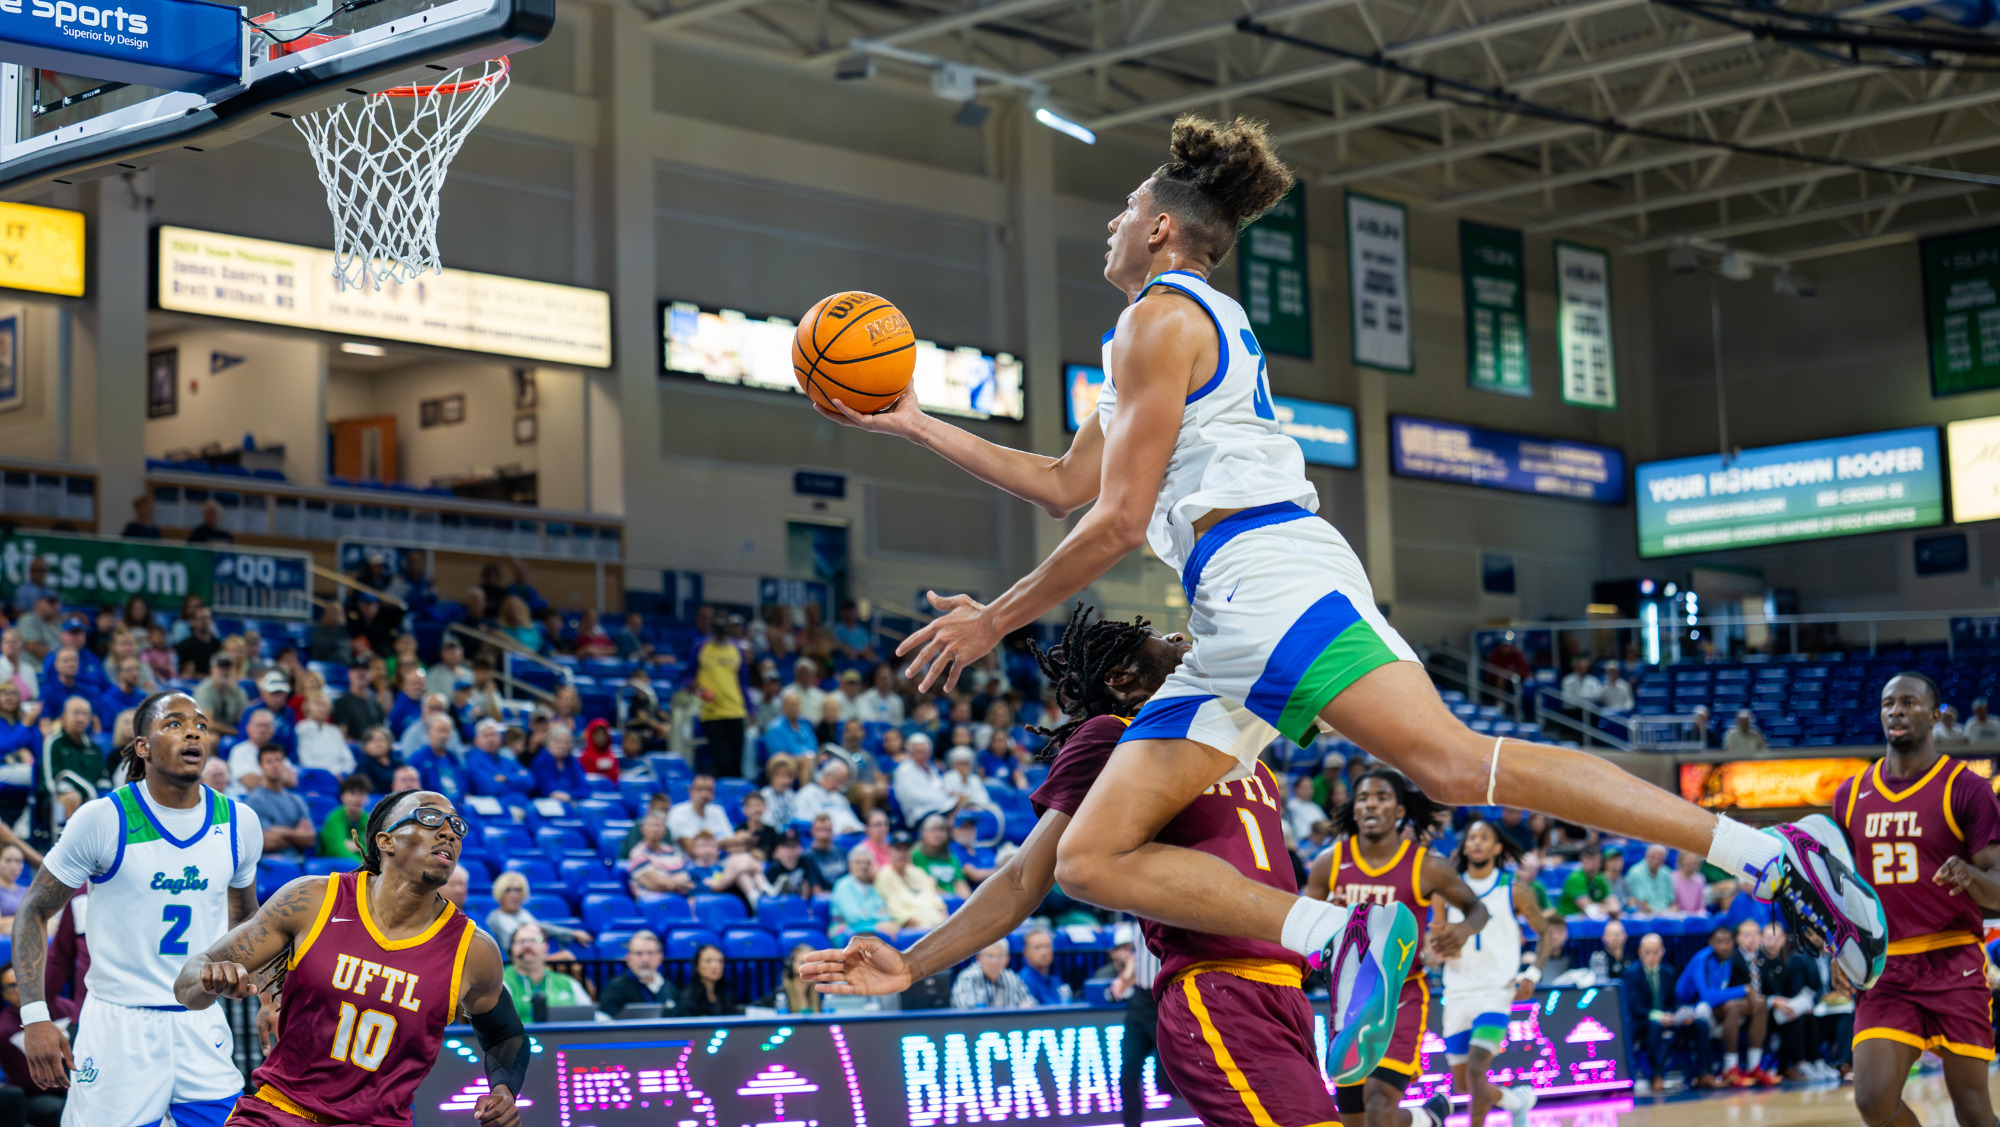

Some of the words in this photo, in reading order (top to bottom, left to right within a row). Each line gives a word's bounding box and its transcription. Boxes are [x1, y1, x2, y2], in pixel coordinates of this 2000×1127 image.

[63, 25, 102, 40] Superior
[104, 31, 115, 45] by
[117, 34, 149, 49] Design
[1648, 473, 1707, 503] YOUR
[1709, 457, 1834, 496] HOMETOWN
[1836, 446, 1924, 480] ROOFER
[1202, 775, 1277, 811] TL
[1235, 806, 1272, 872] 1
[1864, 810, 1923, 838] UFTL
[150, 864, 209, 896] Eagles
[1871, 841, 1920, 886] 23
[159, 903, 192, 956] 2
[331, 952, 421, 1013] UFTL
[330, 1000, 399, 1073] 10
[901, 1024, 1172, 1127] BACKYA
